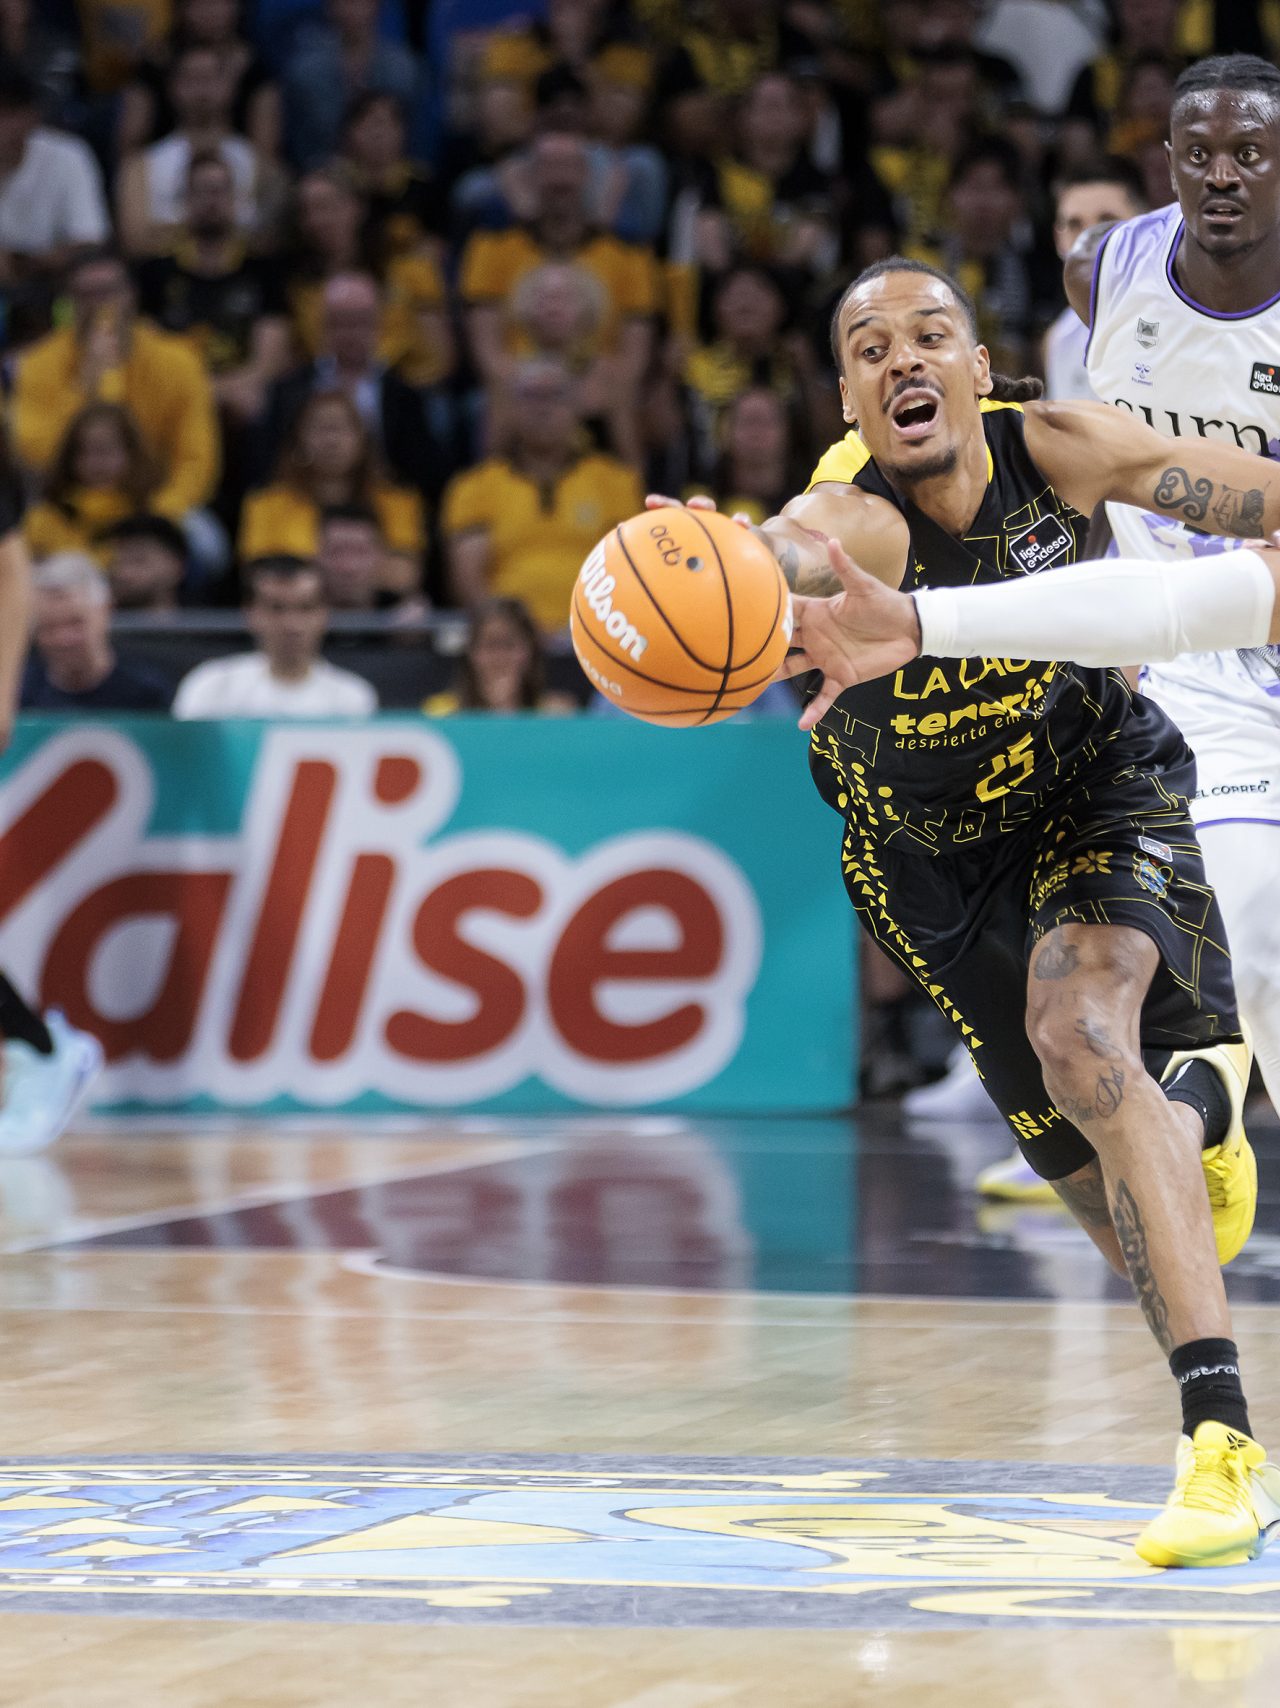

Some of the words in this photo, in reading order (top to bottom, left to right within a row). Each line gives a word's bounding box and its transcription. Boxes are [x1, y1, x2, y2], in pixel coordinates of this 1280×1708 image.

[1253, 369, 1272, 383] liga
[649, 524, 683, 567] acb
[1018, 542, 1042, 561] liga
[1027, 535, 1068, 569] endesa
[893, 666, 951, 700] LA
[894, 724, 987, 750] despierta
[975, 731, 1035, 803] 25
[1211, 784, 1267, 797] CORREO
